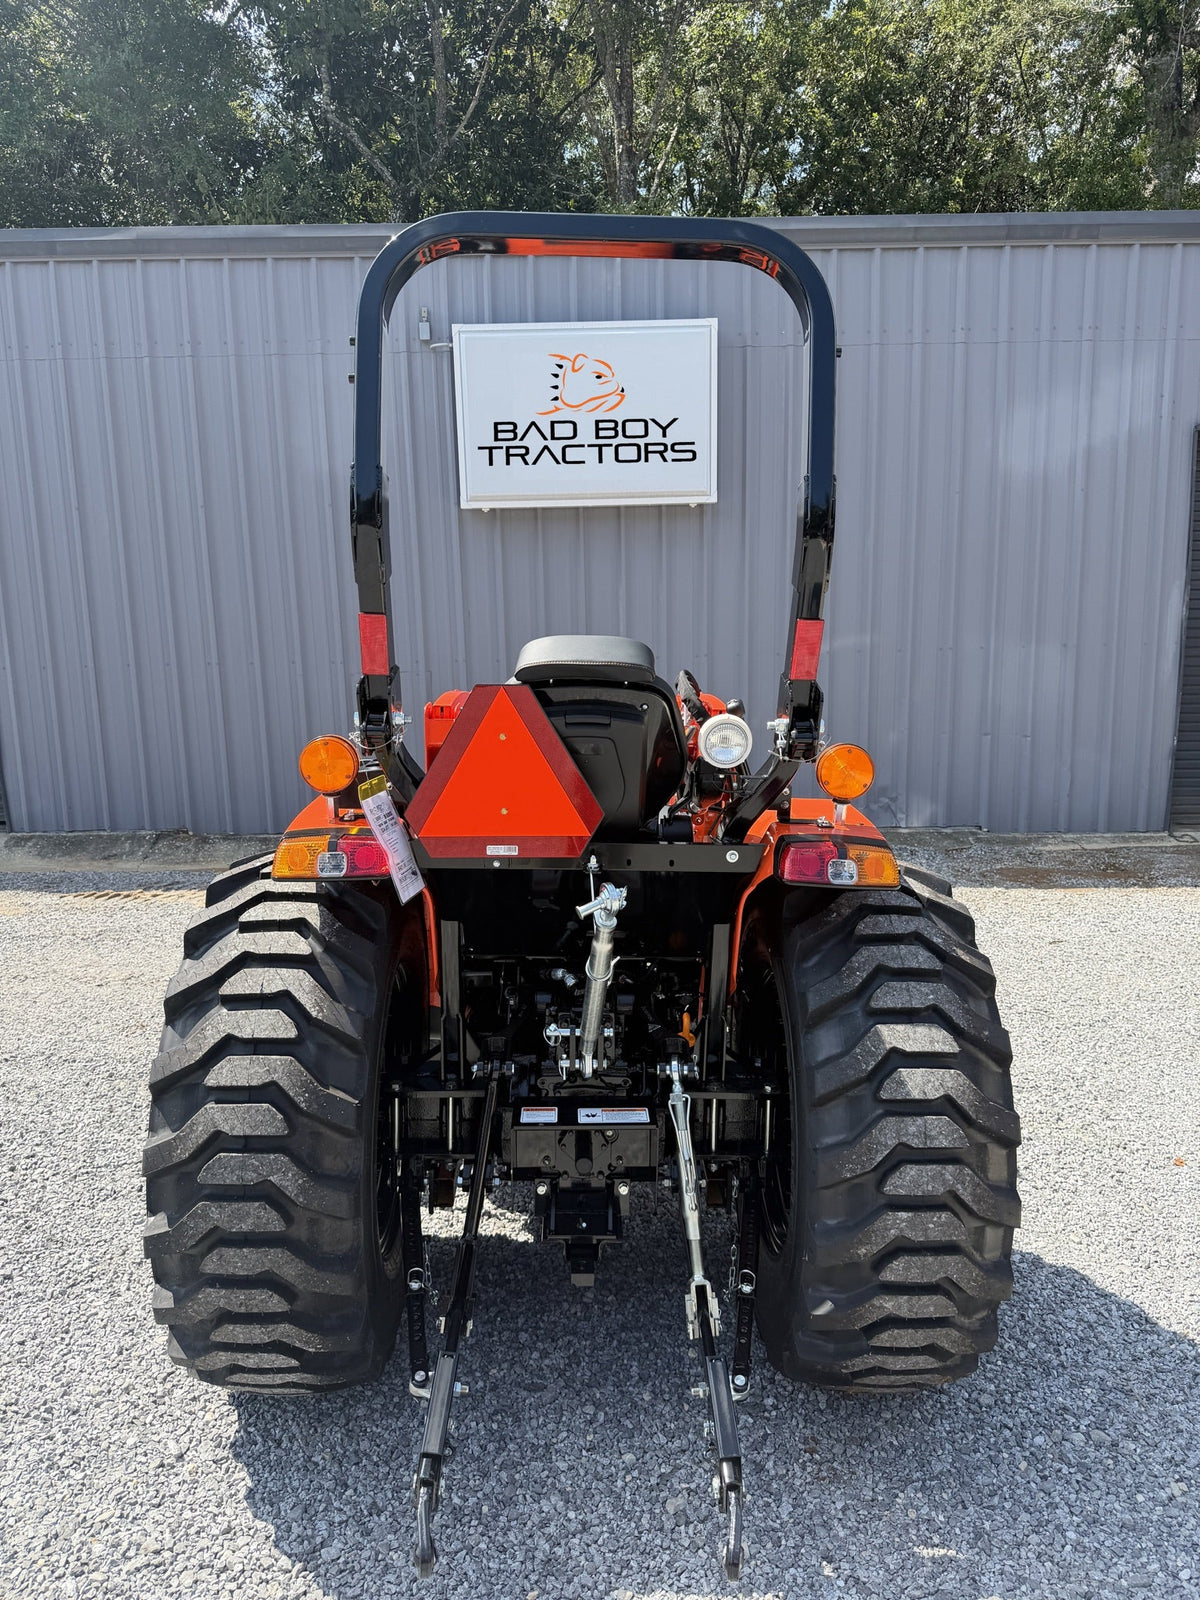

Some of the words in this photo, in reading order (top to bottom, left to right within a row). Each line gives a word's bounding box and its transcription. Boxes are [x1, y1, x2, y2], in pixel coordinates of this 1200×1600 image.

[493, 420, 578, 442] BAD
[594, 417, 679, 440] BOY
[477, 441, 697, 467] TRACTORS
